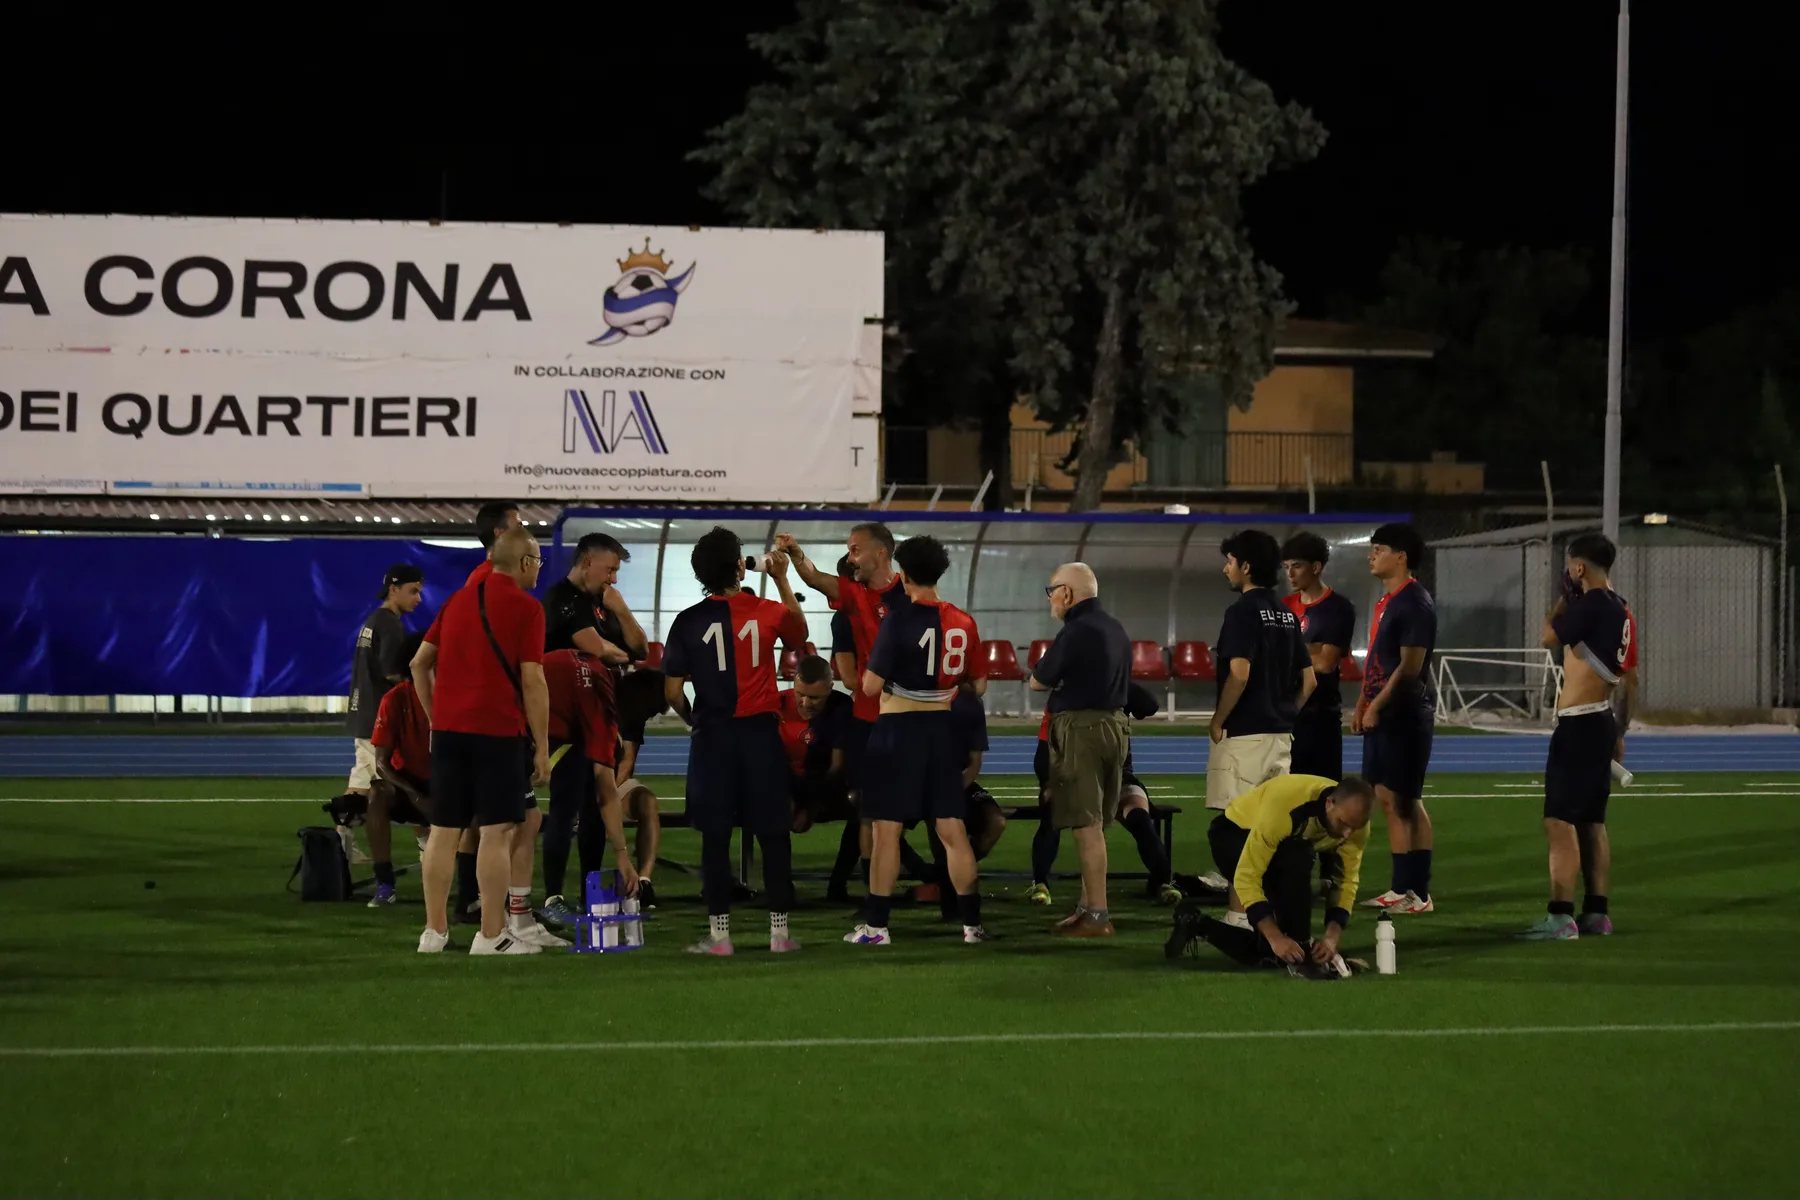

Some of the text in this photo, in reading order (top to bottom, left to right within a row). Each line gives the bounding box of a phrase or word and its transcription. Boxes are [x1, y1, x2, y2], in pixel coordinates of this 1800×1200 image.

[0, 255, 533, 322] A CORONA
[514, 365, 726, 381] IN COLLABORAZIONE CON
[102, 392, 477, 439] QUARTIERI
[563, 389, 669, 455] NA
[504, 463, 728, 480] info@nuovaaccoppiatura.com
[850, 446, 865, 468] T
[701, 619, 760, 672] 11
[917, 627, 968, 676] 18
[1616, 618, 1631, 663] 9
